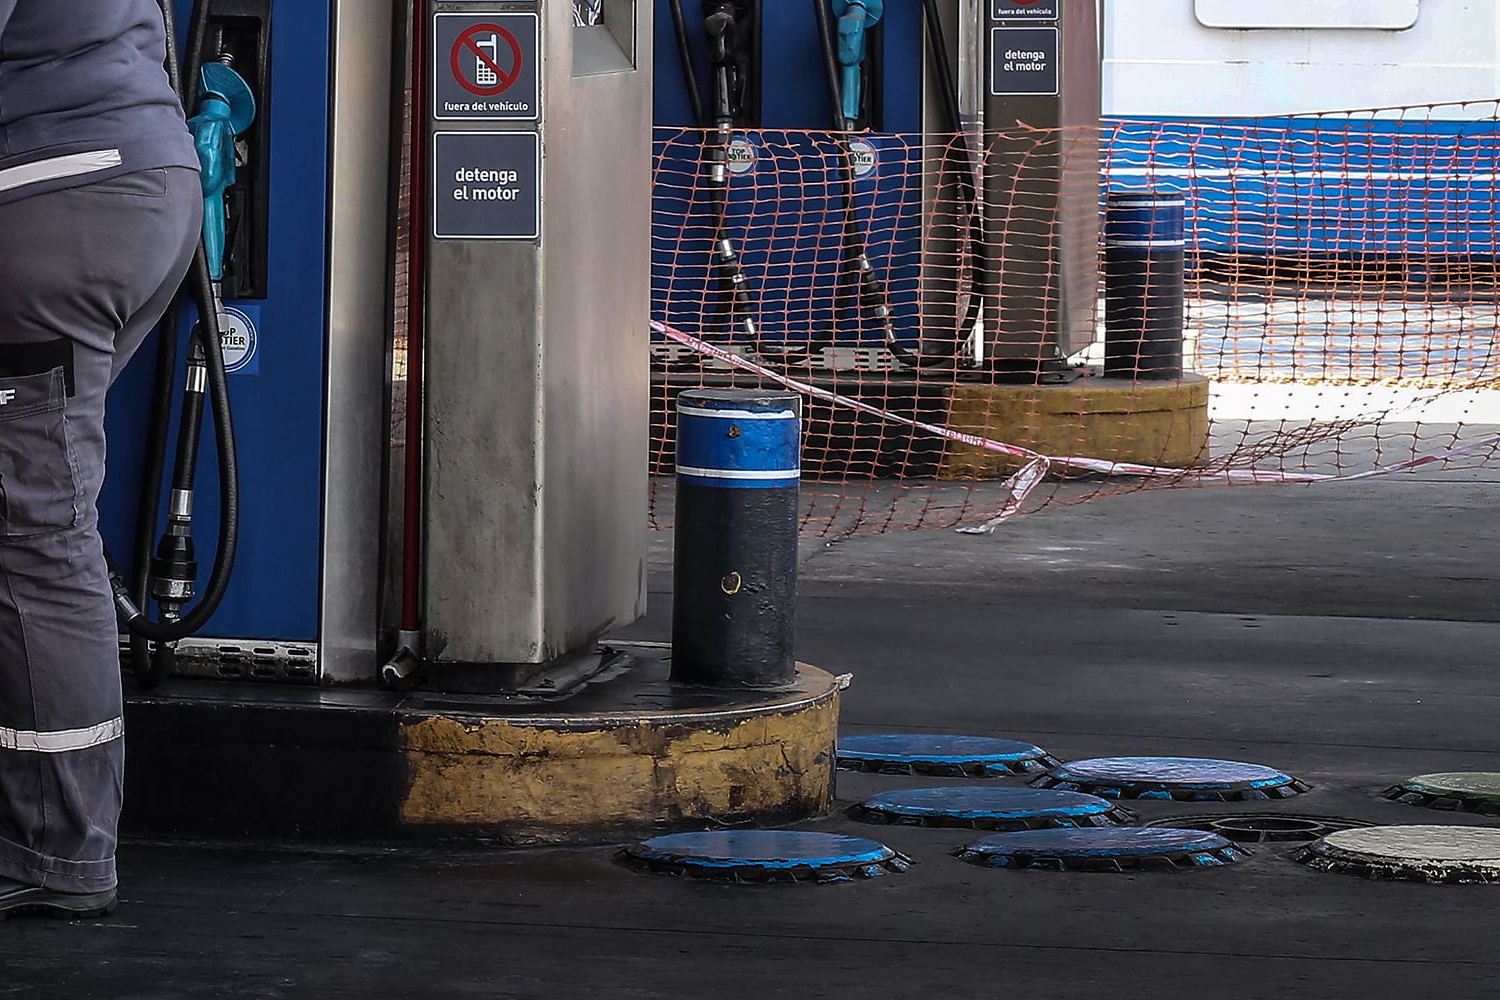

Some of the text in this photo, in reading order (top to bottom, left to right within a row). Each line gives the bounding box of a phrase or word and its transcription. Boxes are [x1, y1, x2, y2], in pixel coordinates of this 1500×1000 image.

[1005, 50, 1045, 61] detenga
[1004, 61, 1047, 71] el motor
[444, 101, 529, 111] fuera del vehículo
[455, 167, 517, 185] detenga
[453, 185, 520, 200] el motor
